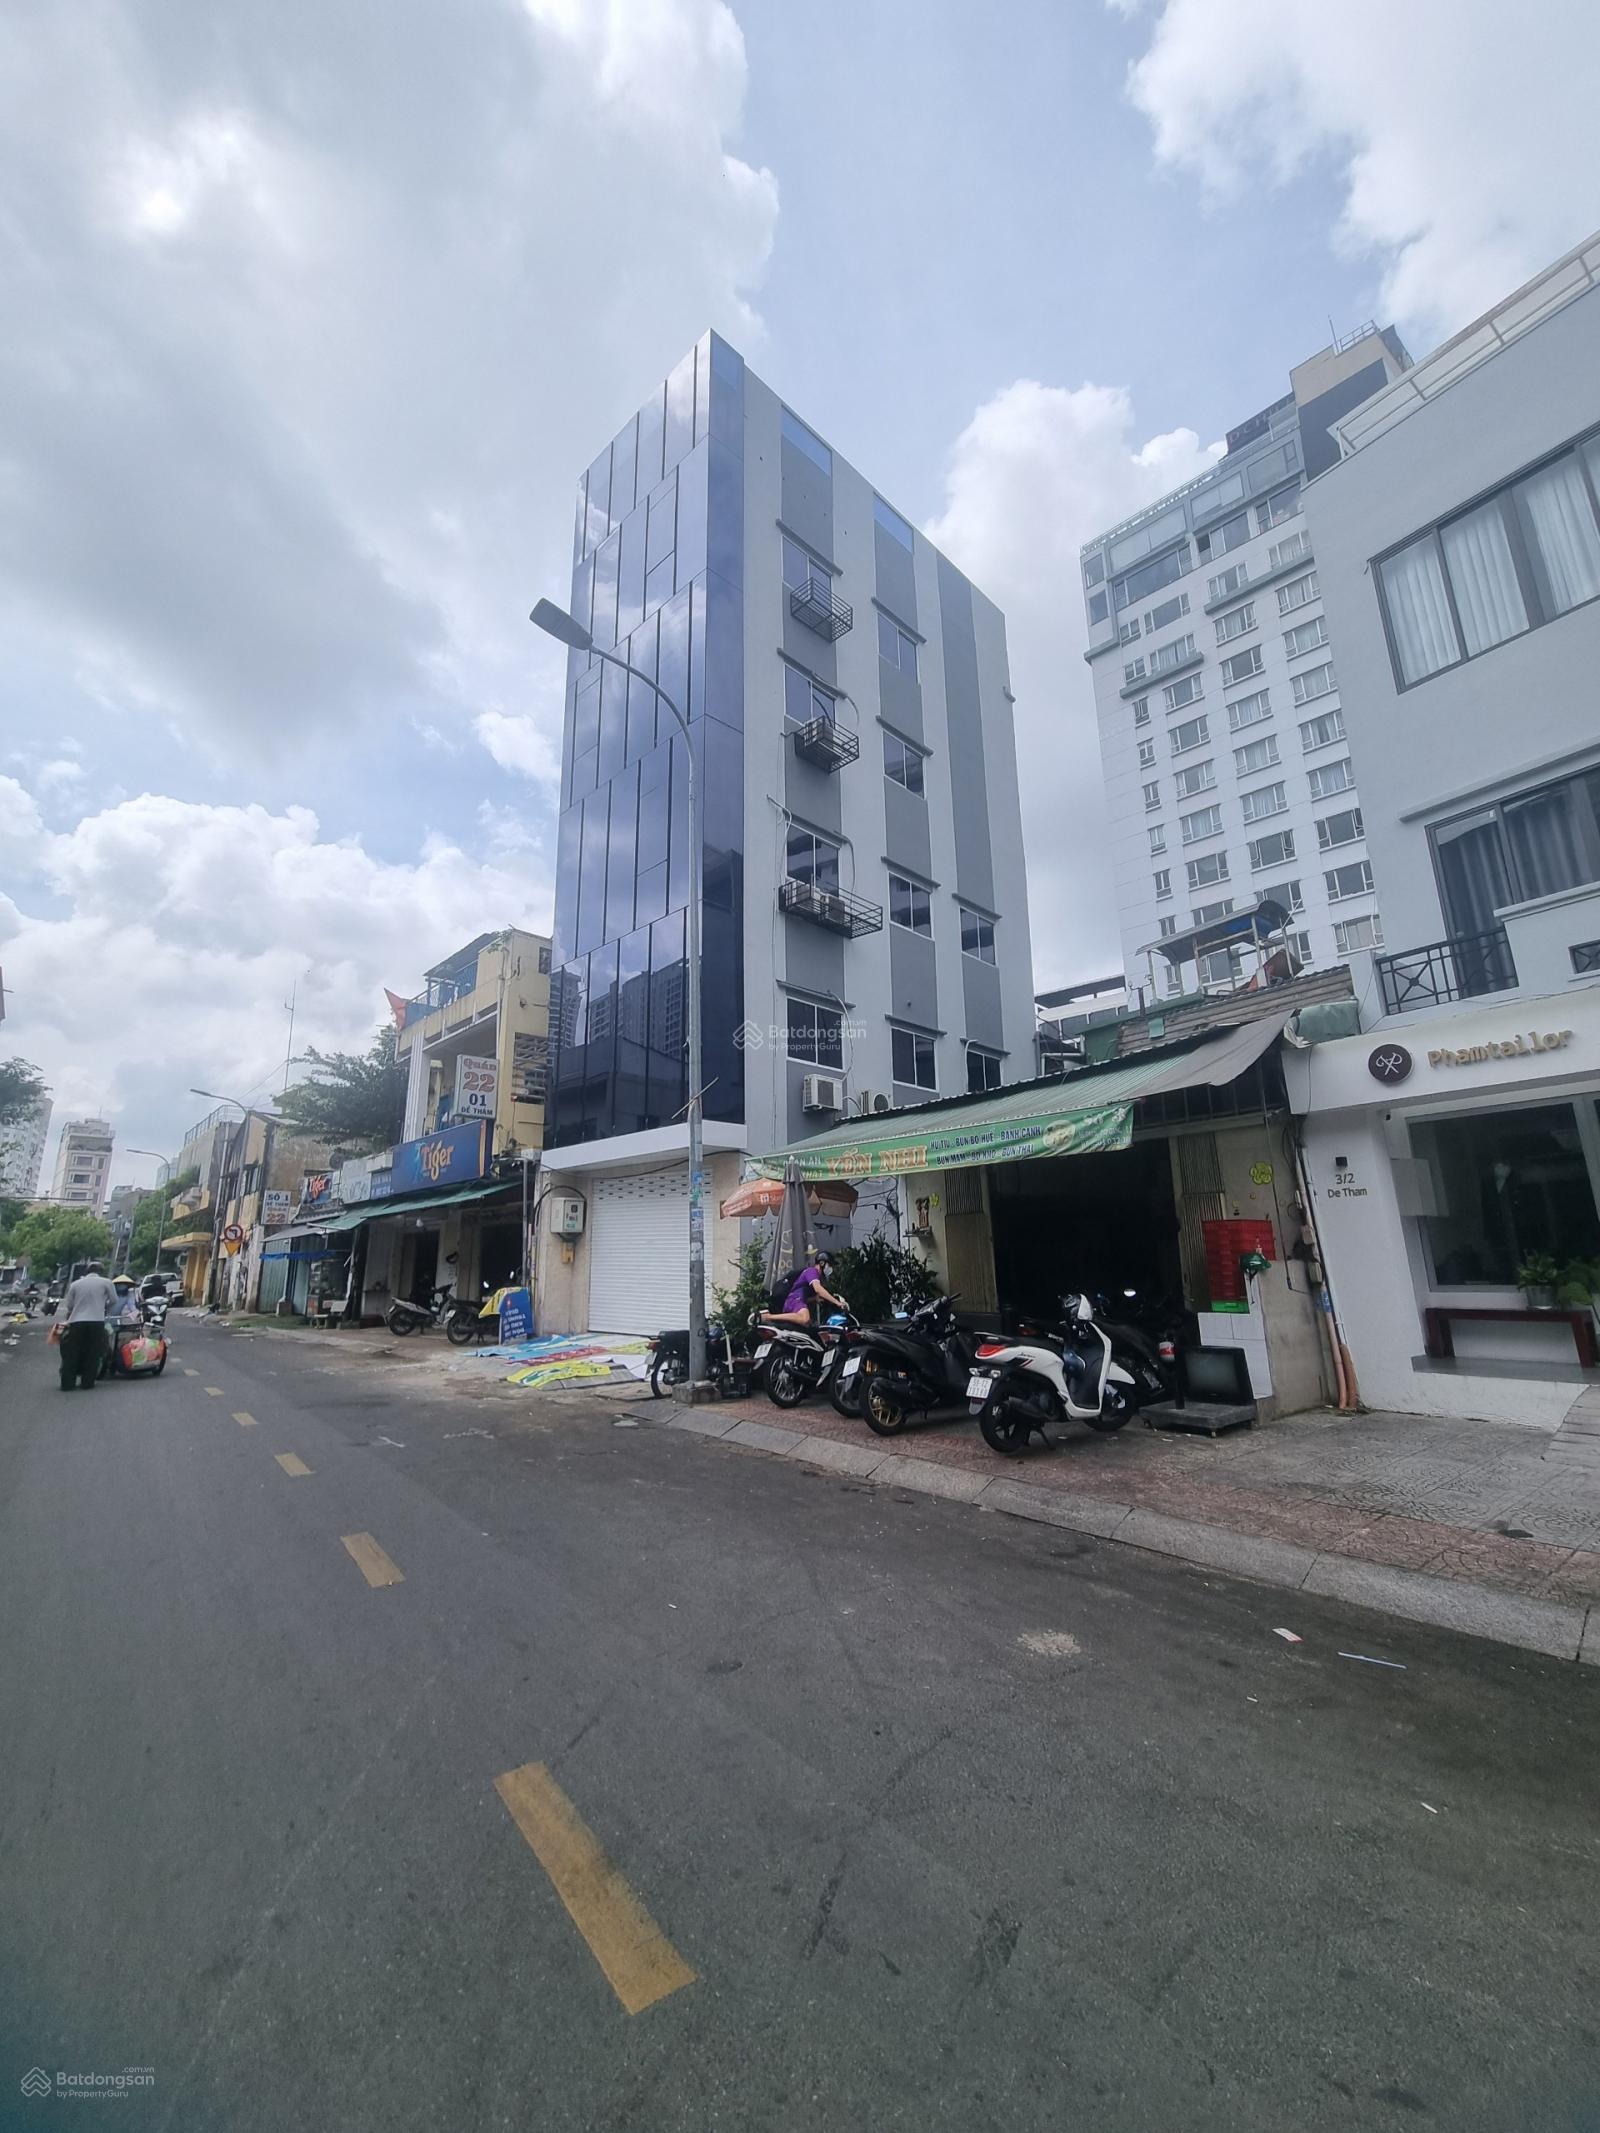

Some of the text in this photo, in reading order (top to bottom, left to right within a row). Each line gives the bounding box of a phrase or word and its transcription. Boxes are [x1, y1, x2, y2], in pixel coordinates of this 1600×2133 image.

[1427, 1029, 1573, 1069] Phamtailor
[463, 1071, 495, 1092] 22
[469, 1094, 487, 1106] 01
[421, 1140, 455, 1181] Tiger
[879, 1145, 928, 1172] NHI
[309, 1175, 328, 1199] Tiger
[1335, 1173, 1355, 1185] 3/2
[1327, 1188, 1368, 1198] De Tham
[266, 1213, 286, 1223] 22
